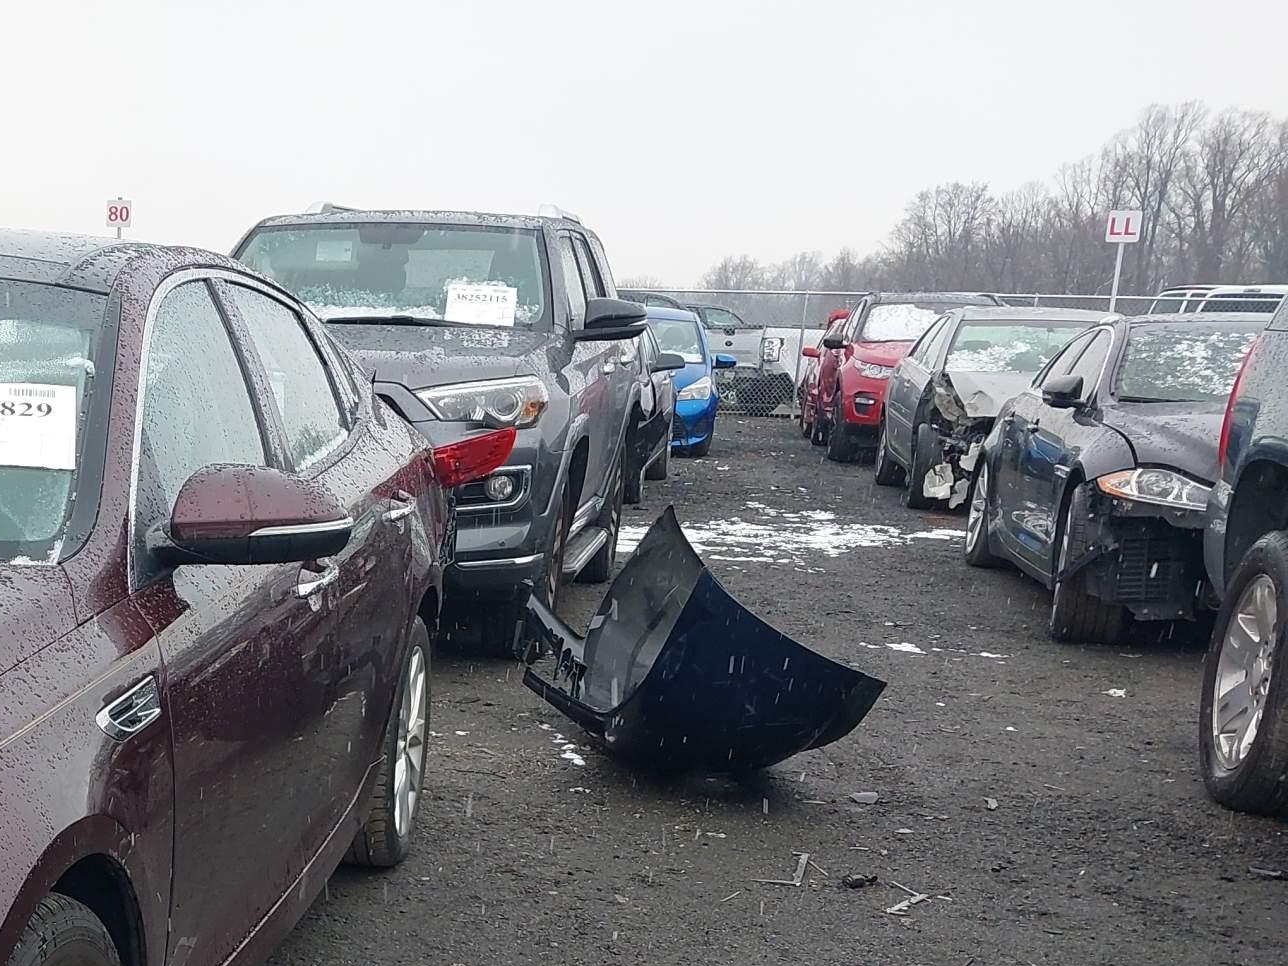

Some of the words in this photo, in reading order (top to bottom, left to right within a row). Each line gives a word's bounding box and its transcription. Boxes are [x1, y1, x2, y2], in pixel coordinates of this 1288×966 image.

[108, 205, 130, 222] 80
[1109, 216, 1137, 236] LL
[454, 293, 508, 304] 38252115
